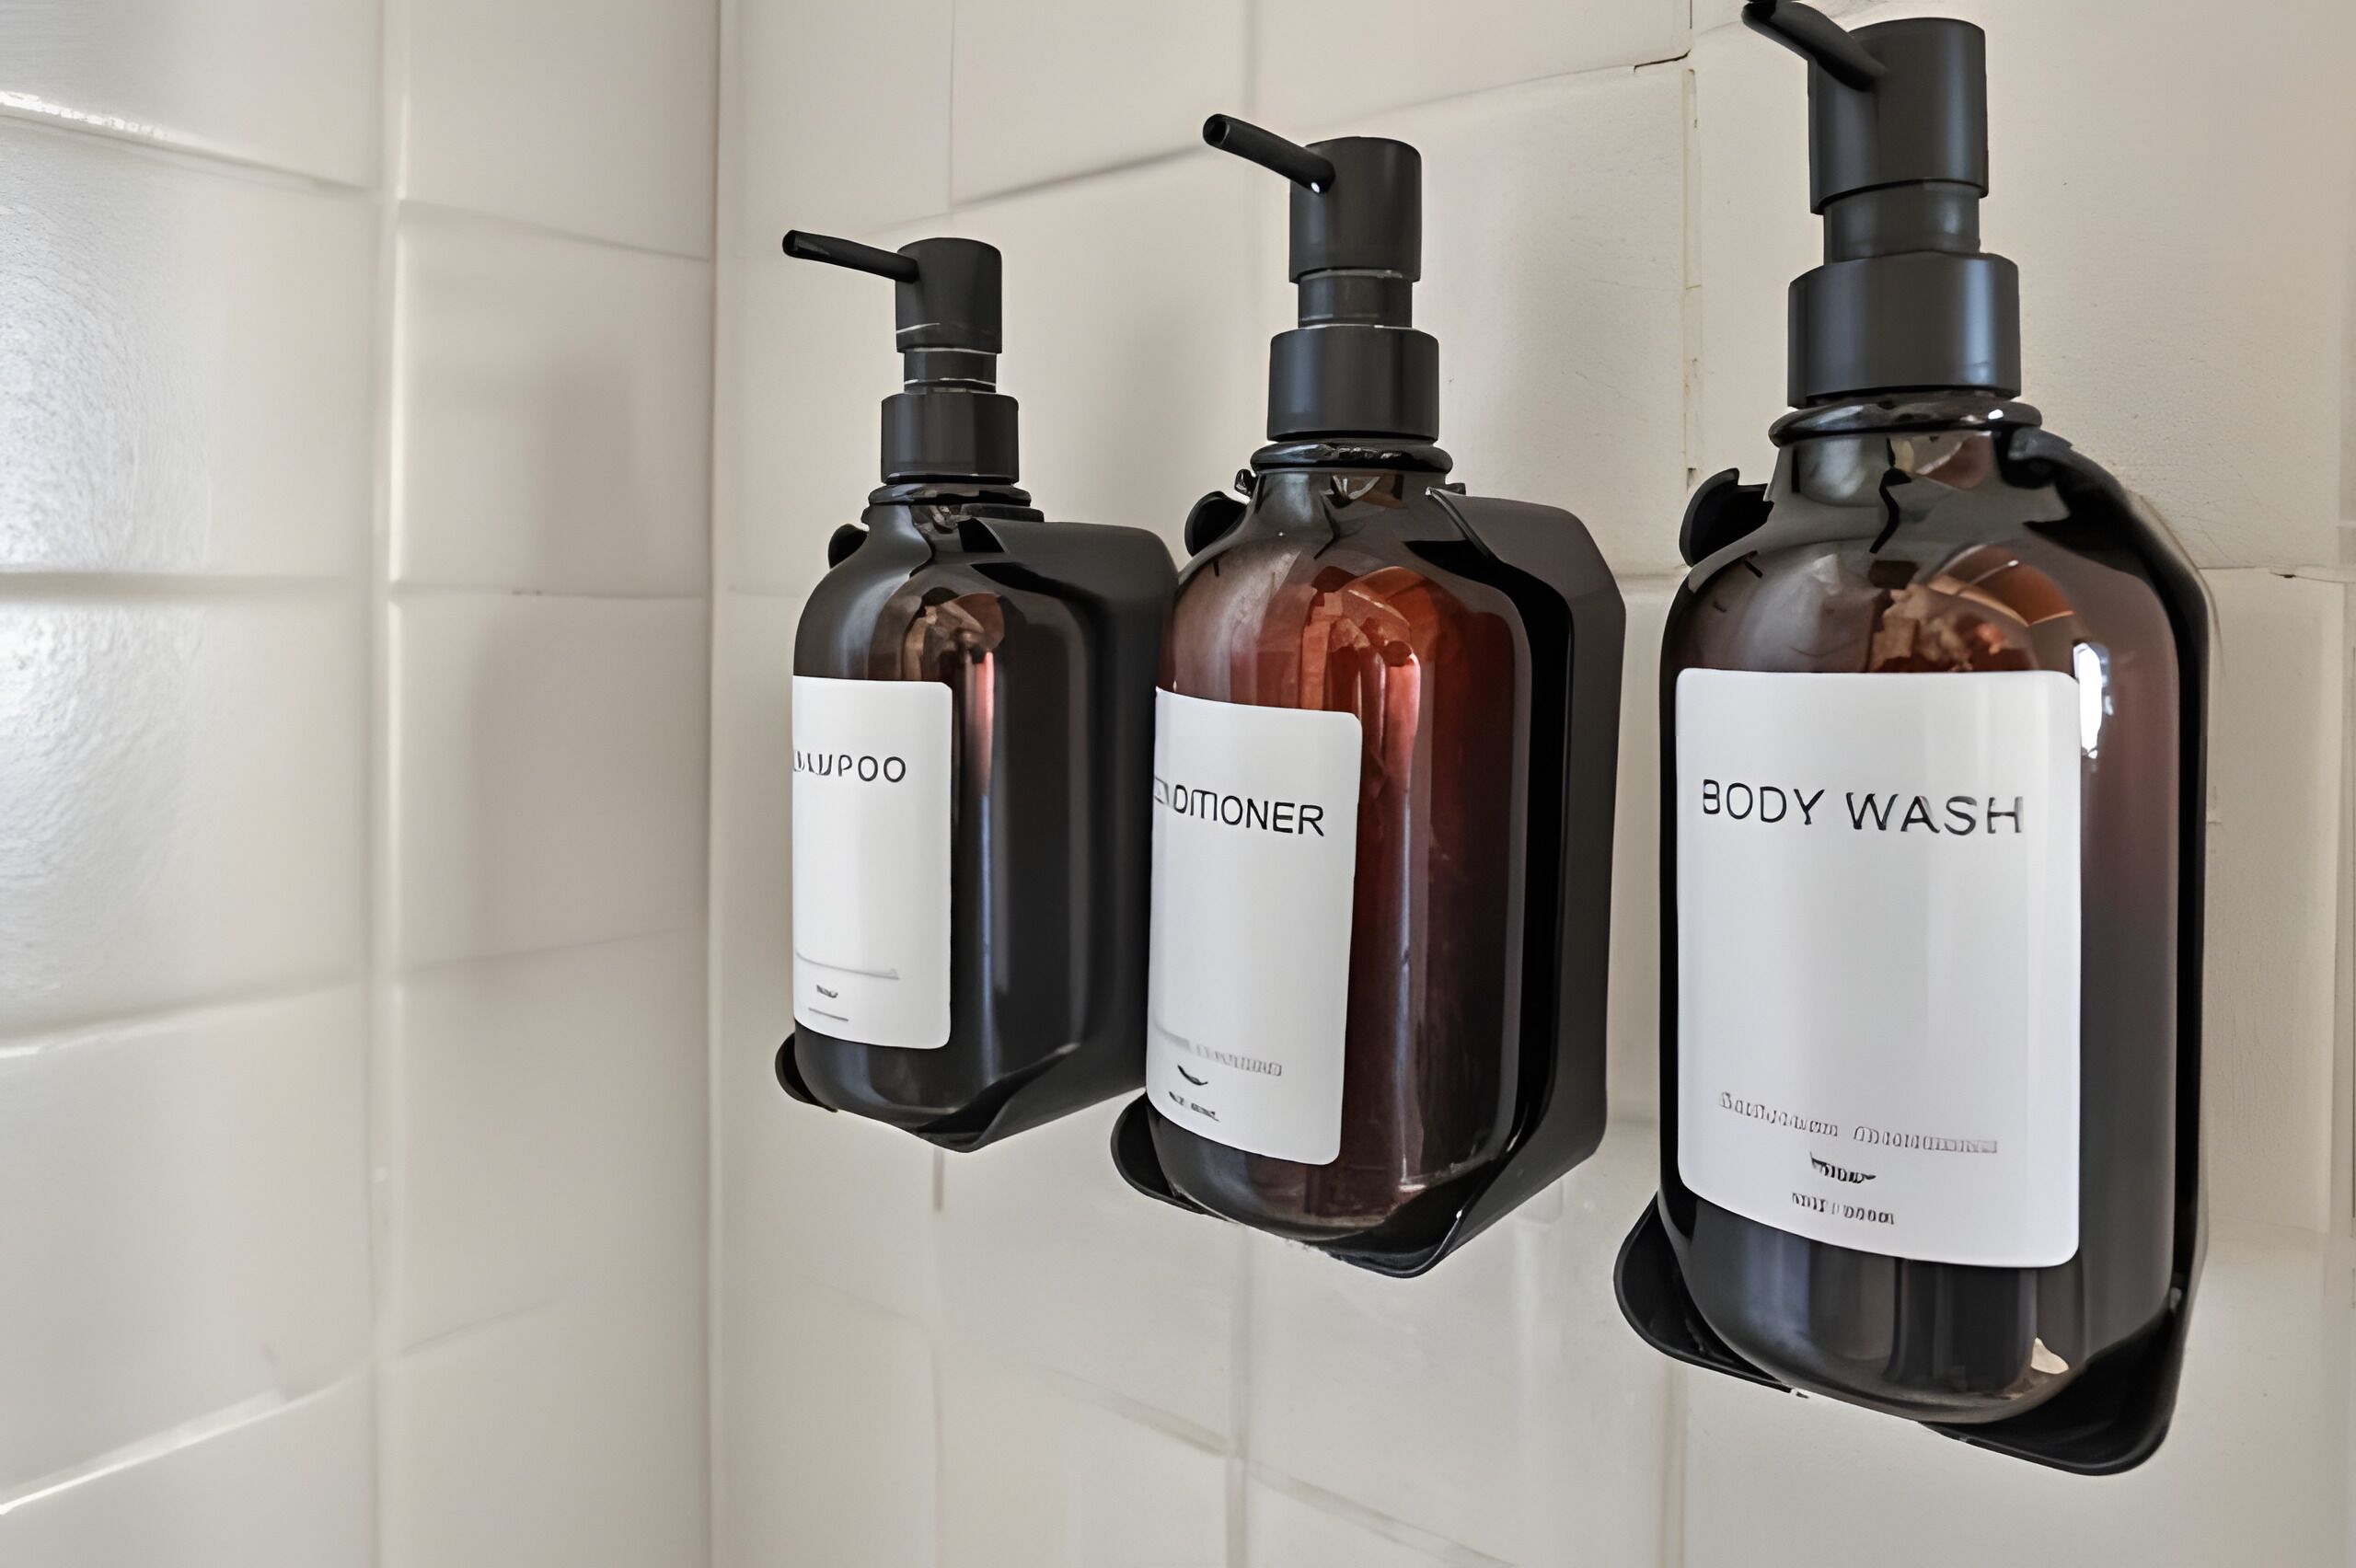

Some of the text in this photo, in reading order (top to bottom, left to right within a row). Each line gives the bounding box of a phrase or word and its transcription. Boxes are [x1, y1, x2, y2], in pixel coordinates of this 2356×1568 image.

[1155, 777, 1324, 836] DITIONER
[1703, 778, 2024, 836] BODY WASH
